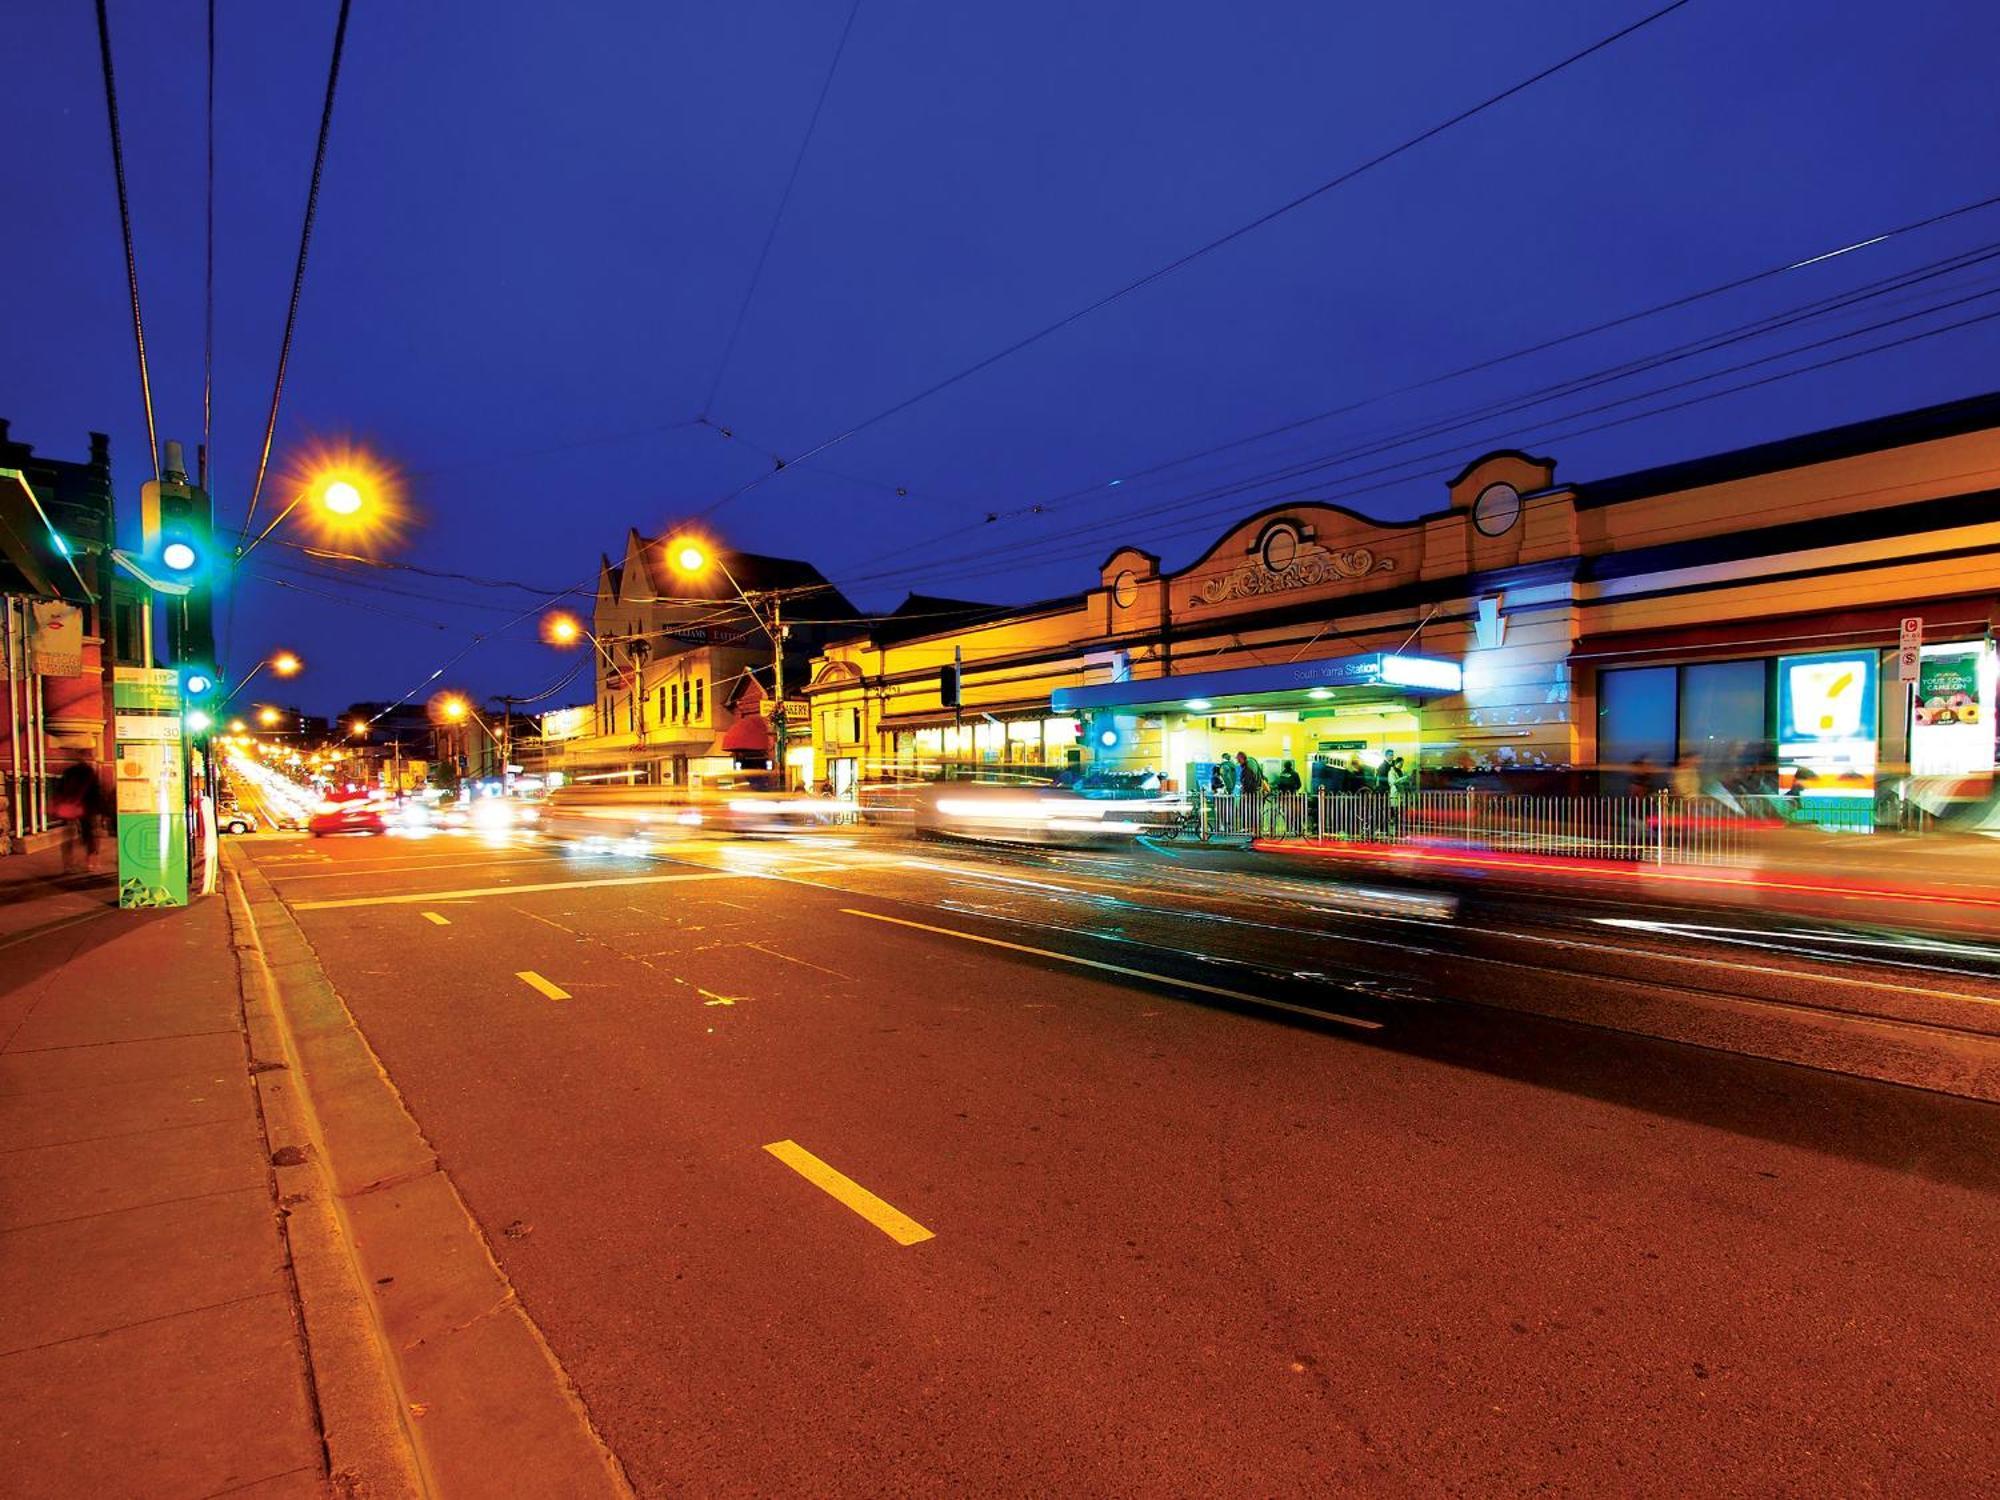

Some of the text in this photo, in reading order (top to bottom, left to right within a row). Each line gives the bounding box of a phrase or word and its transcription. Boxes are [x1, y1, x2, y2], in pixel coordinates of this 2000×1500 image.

[1294, 663, 1378, 680] South Yarra Station
[163, 727, 178, 736] 30
